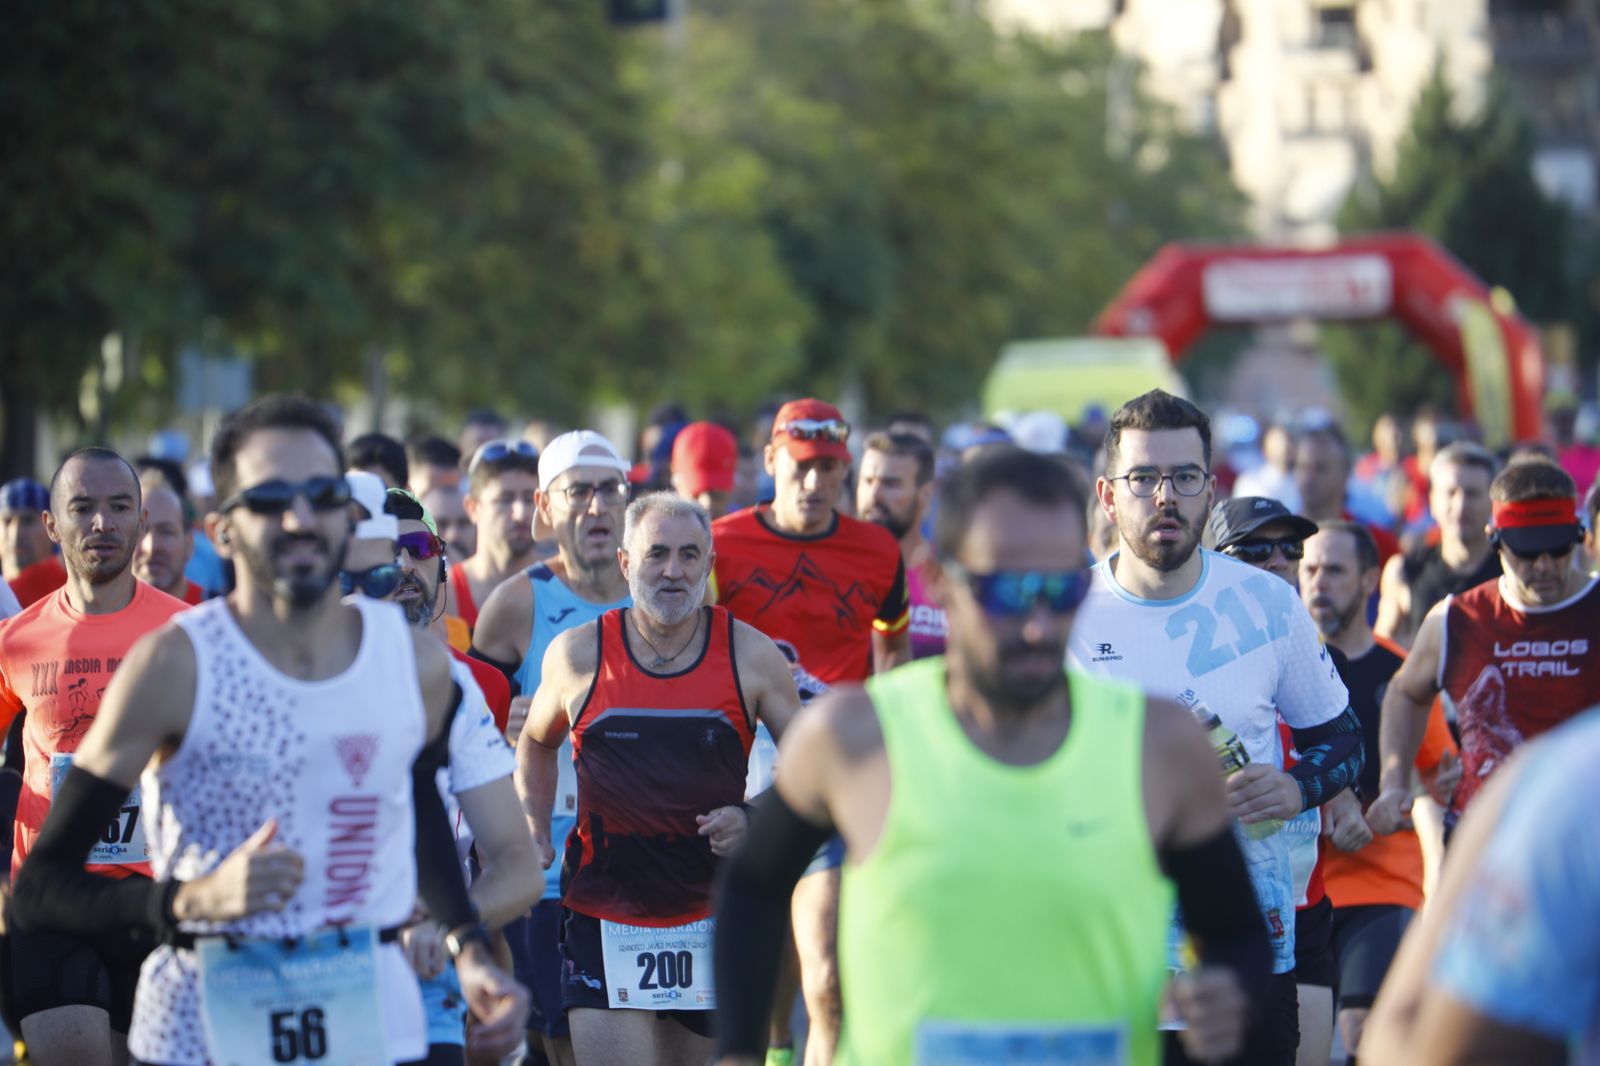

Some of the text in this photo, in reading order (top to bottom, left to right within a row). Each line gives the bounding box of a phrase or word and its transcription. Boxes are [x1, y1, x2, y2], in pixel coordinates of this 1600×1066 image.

[1494, 639, 1588, 657] LOBOS
[64, 657, 101, 674] MEDIA
[1501, 660, 1580, 678] TRAIL
[637, 950, 693, 989] 200
[271, 1008, 327, 1064] 56
